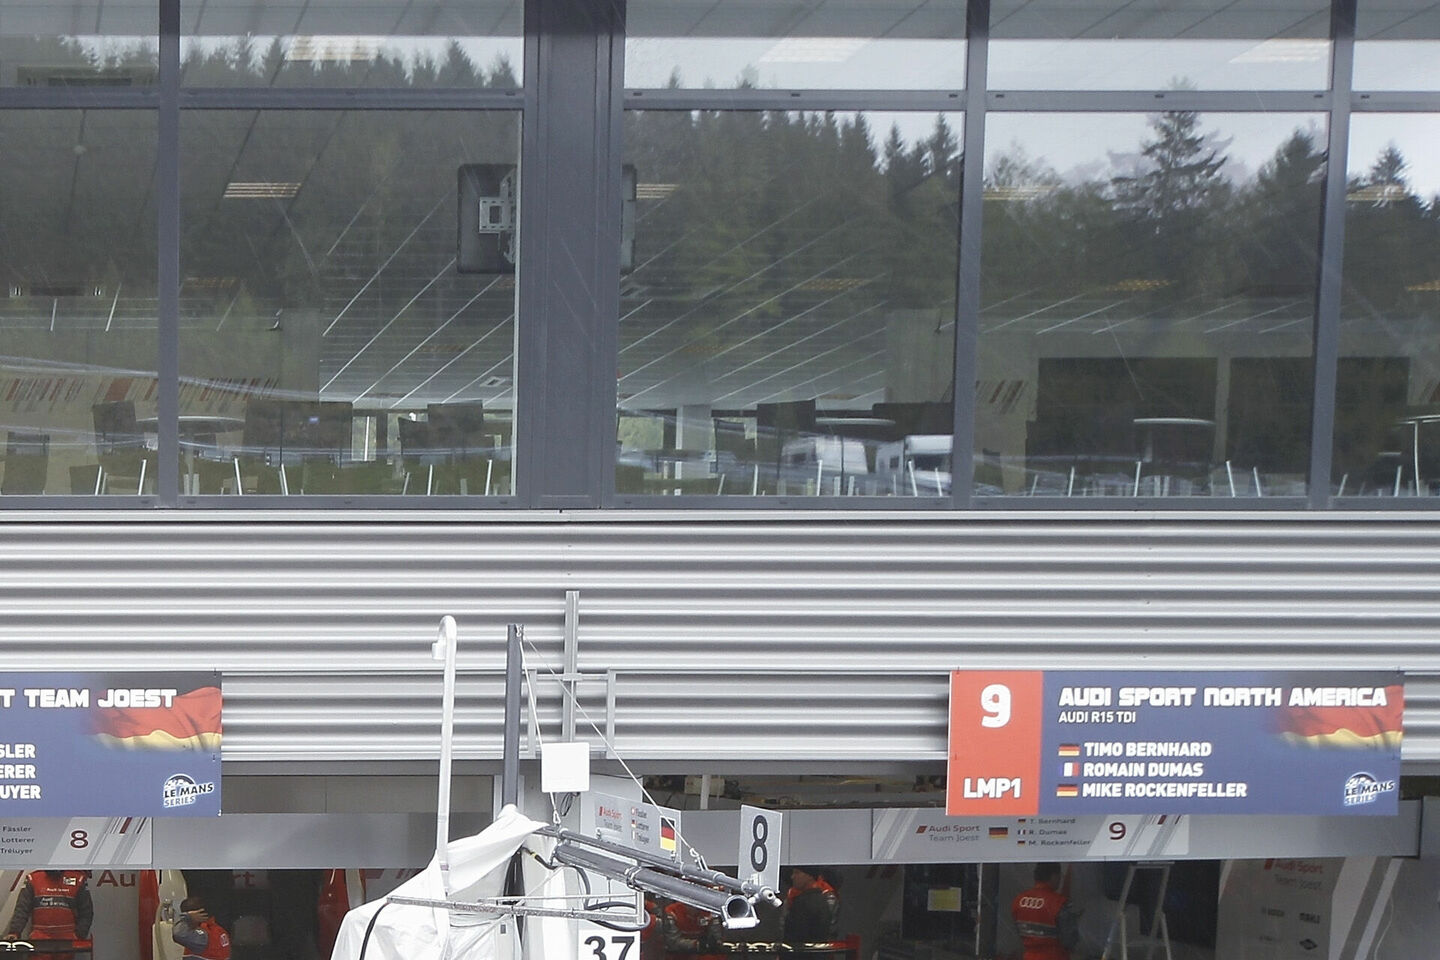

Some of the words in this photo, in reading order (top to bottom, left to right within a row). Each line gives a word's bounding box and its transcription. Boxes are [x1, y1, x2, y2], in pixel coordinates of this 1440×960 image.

[24, 689, 89, 708] TEAM
[98, 689, 177, 708] JOEST
[1059, 687, 1111, 706] AUDI
[1119, 687, 1196, 706] SPORT
[1204, 687, 1282, 706] NORTH
[1288, 687, 1387, 706] AMERICA
[980, 684, 1011, 728] 9
[1059, 712, 1088, 723] AUDI
[1091, 712, 1113, 723] R15
[1116, 712, 1136, 723] TDI
[1084, 742, 1123, 757] TIMO
[1125, 742, 1211, 757] BERNHARD
[1084, 763, 1145, 777] ROMAIN
[1148, 763, 1203, 777] DUMAS
[164, 789, 176, 798] LE
[179, 783, 213, 795] MANS
[963, 778, 1021, 798] LMP1
[1083, 783, 1122, 797] MIKE
[1125, 783, 1247, 797] ROCKENFELLER
[1346, 788, 1357, 796] LE
[1361, 781, 1394, 793] MANS
[164, 796, 195, 807] SERIES
[954, 825, 980, 834] Sport
[1109, 822, 1126, 840] 9
[70, 830, 89, 849] 8
[750, 815, 768, 872] 8
[956, 835, 979, 843] Joest
